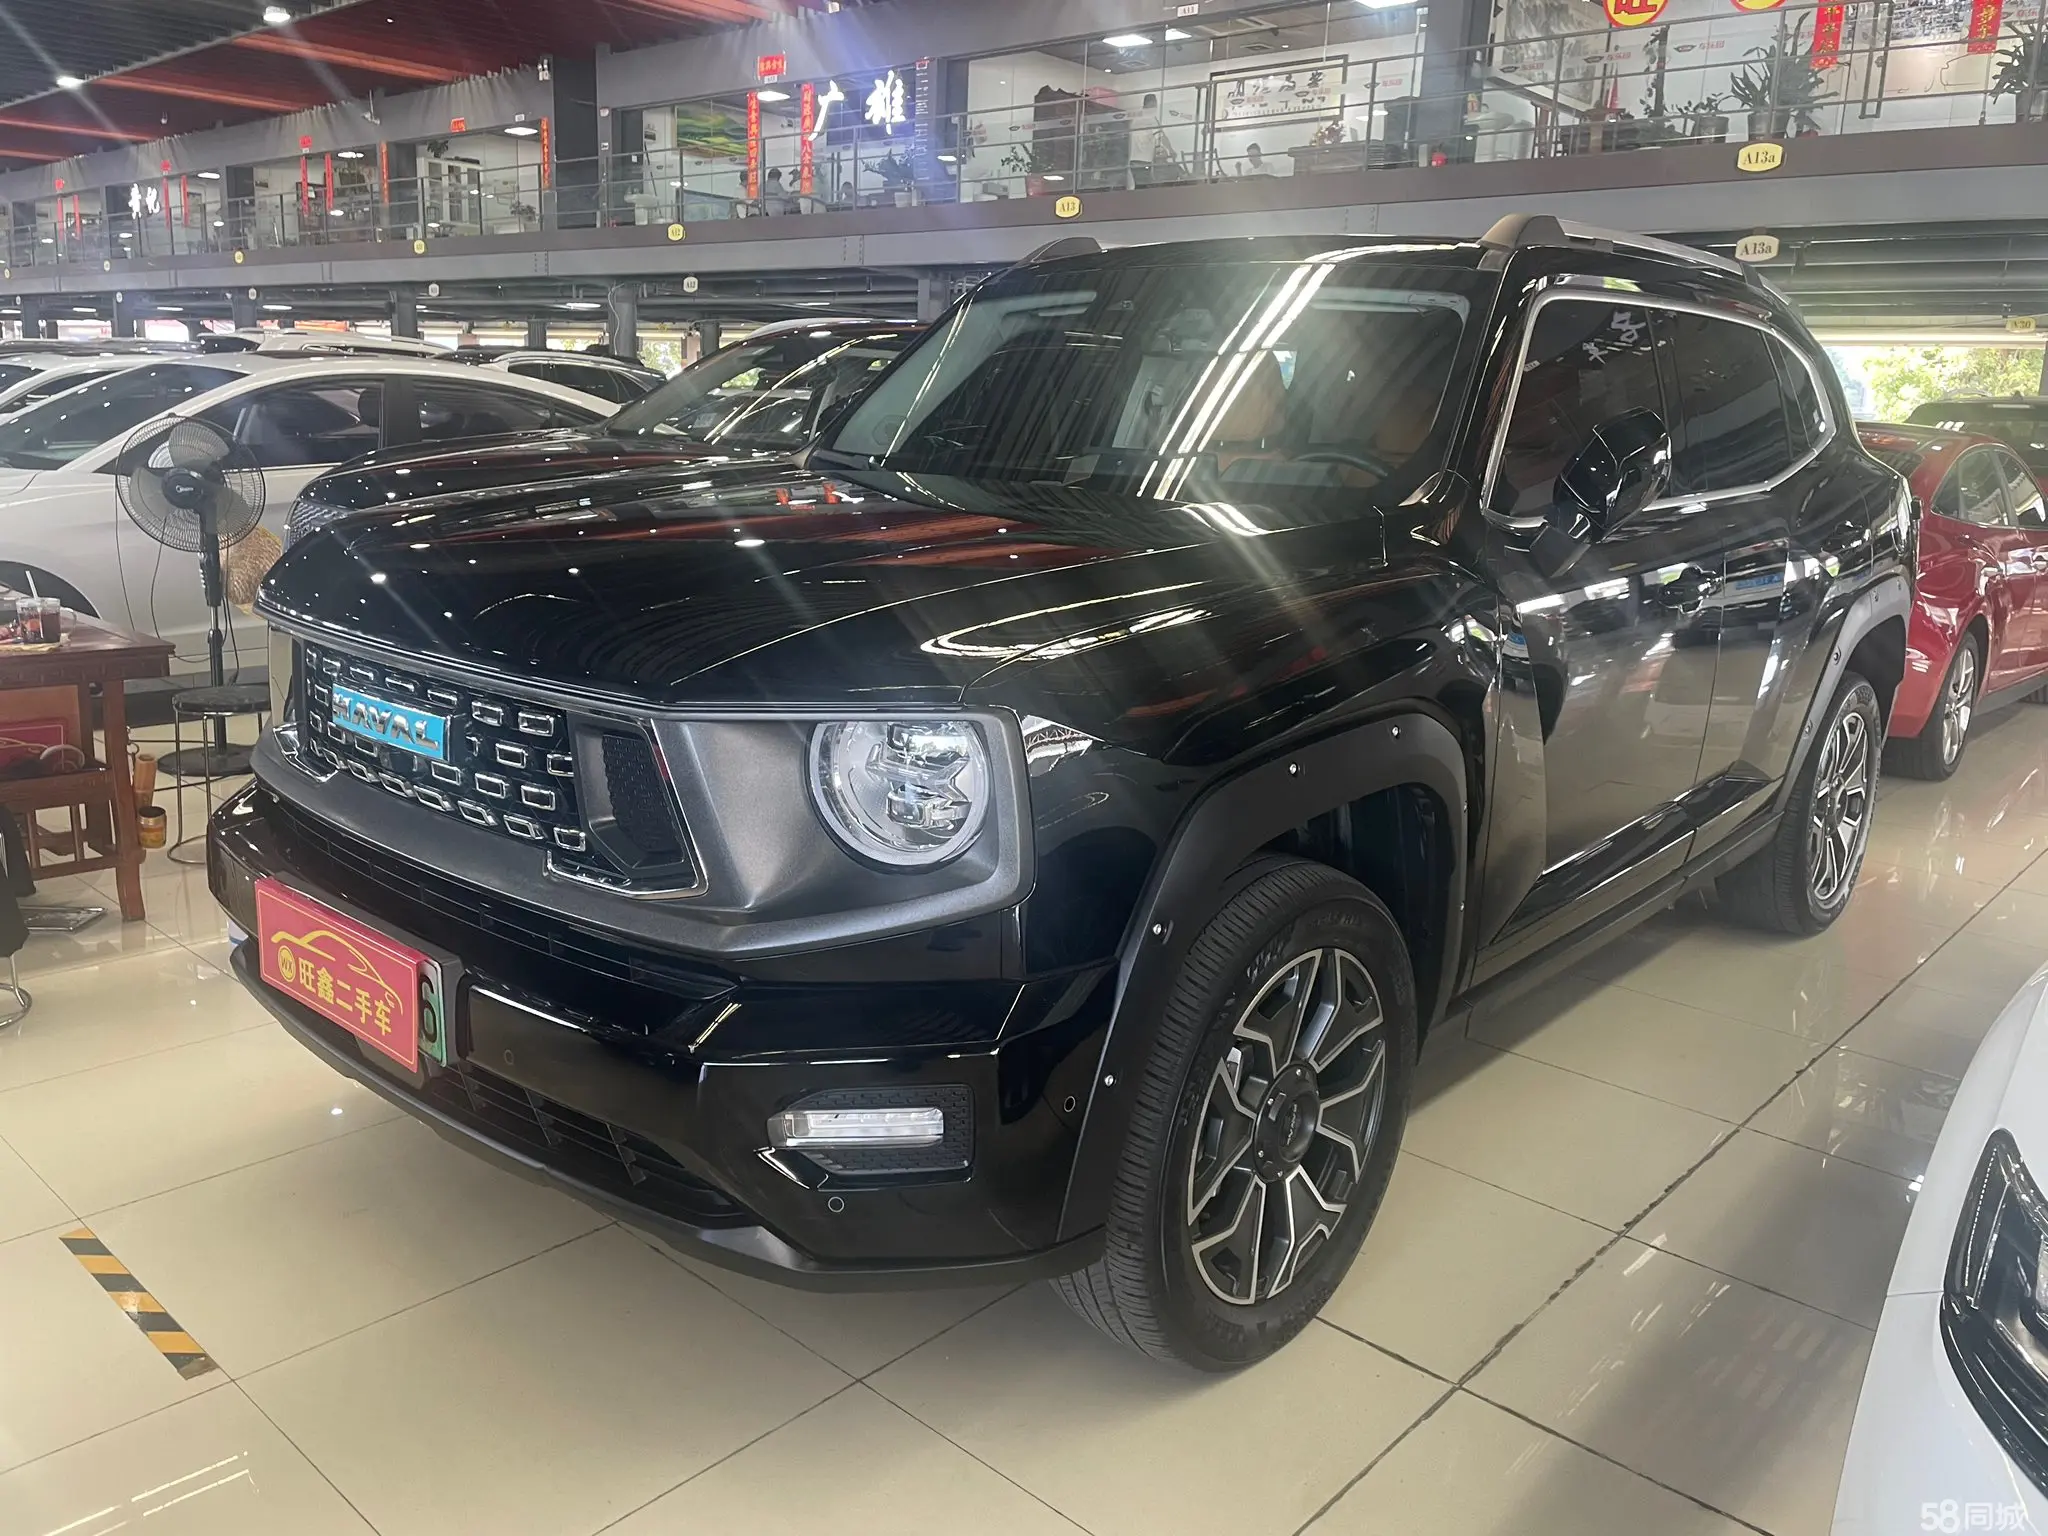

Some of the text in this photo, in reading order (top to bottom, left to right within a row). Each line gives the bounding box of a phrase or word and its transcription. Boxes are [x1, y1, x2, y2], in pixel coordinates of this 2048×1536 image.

[1742, 150, 1776, 166] A13a
[1740, 241, 1772, 256] A13a
[332, 692, 440, 751] HAVAL
[298, 957, 392, 1037] 旺鑫二手车
